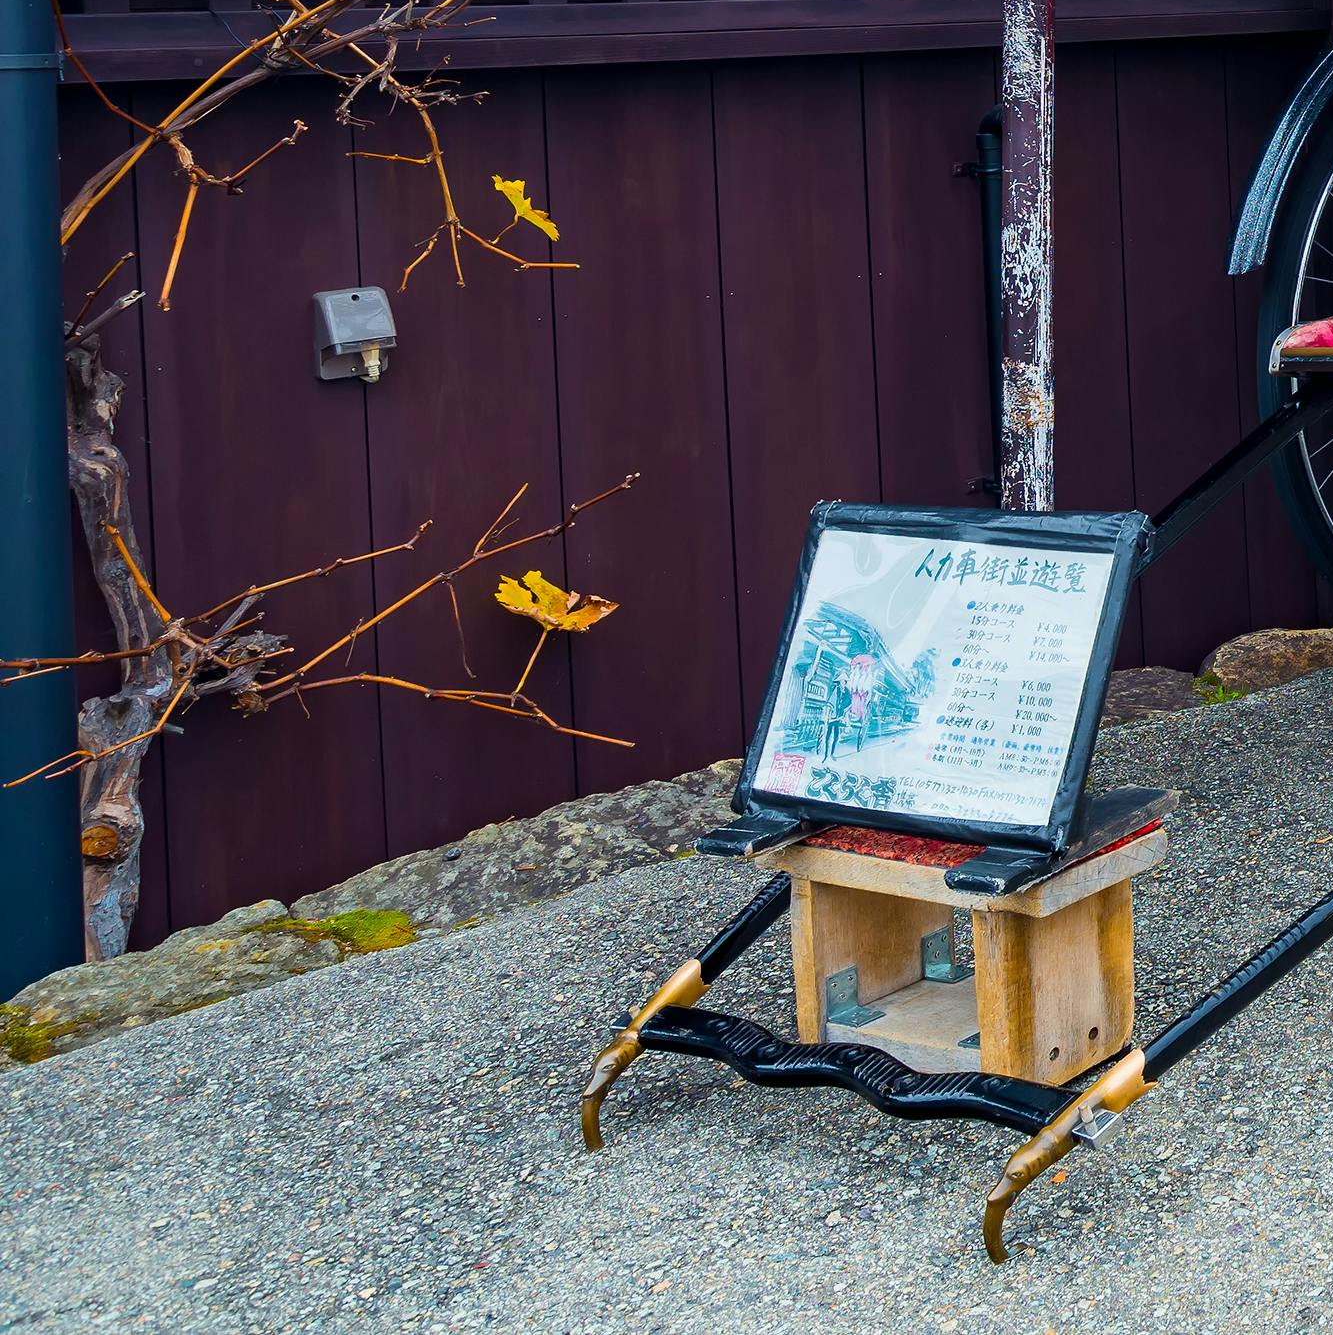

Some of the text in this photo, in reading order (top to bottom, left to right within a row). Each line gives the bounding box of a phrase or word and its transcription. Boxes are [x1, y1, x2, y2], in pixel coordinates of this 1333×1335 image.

[971, 615, 1015, 628] 15分コース
[966, 630, 1011, 643] 30分コース
[955, 673, 999, 686] 15分コース
[951, 687, 996, 701] 30分コース
